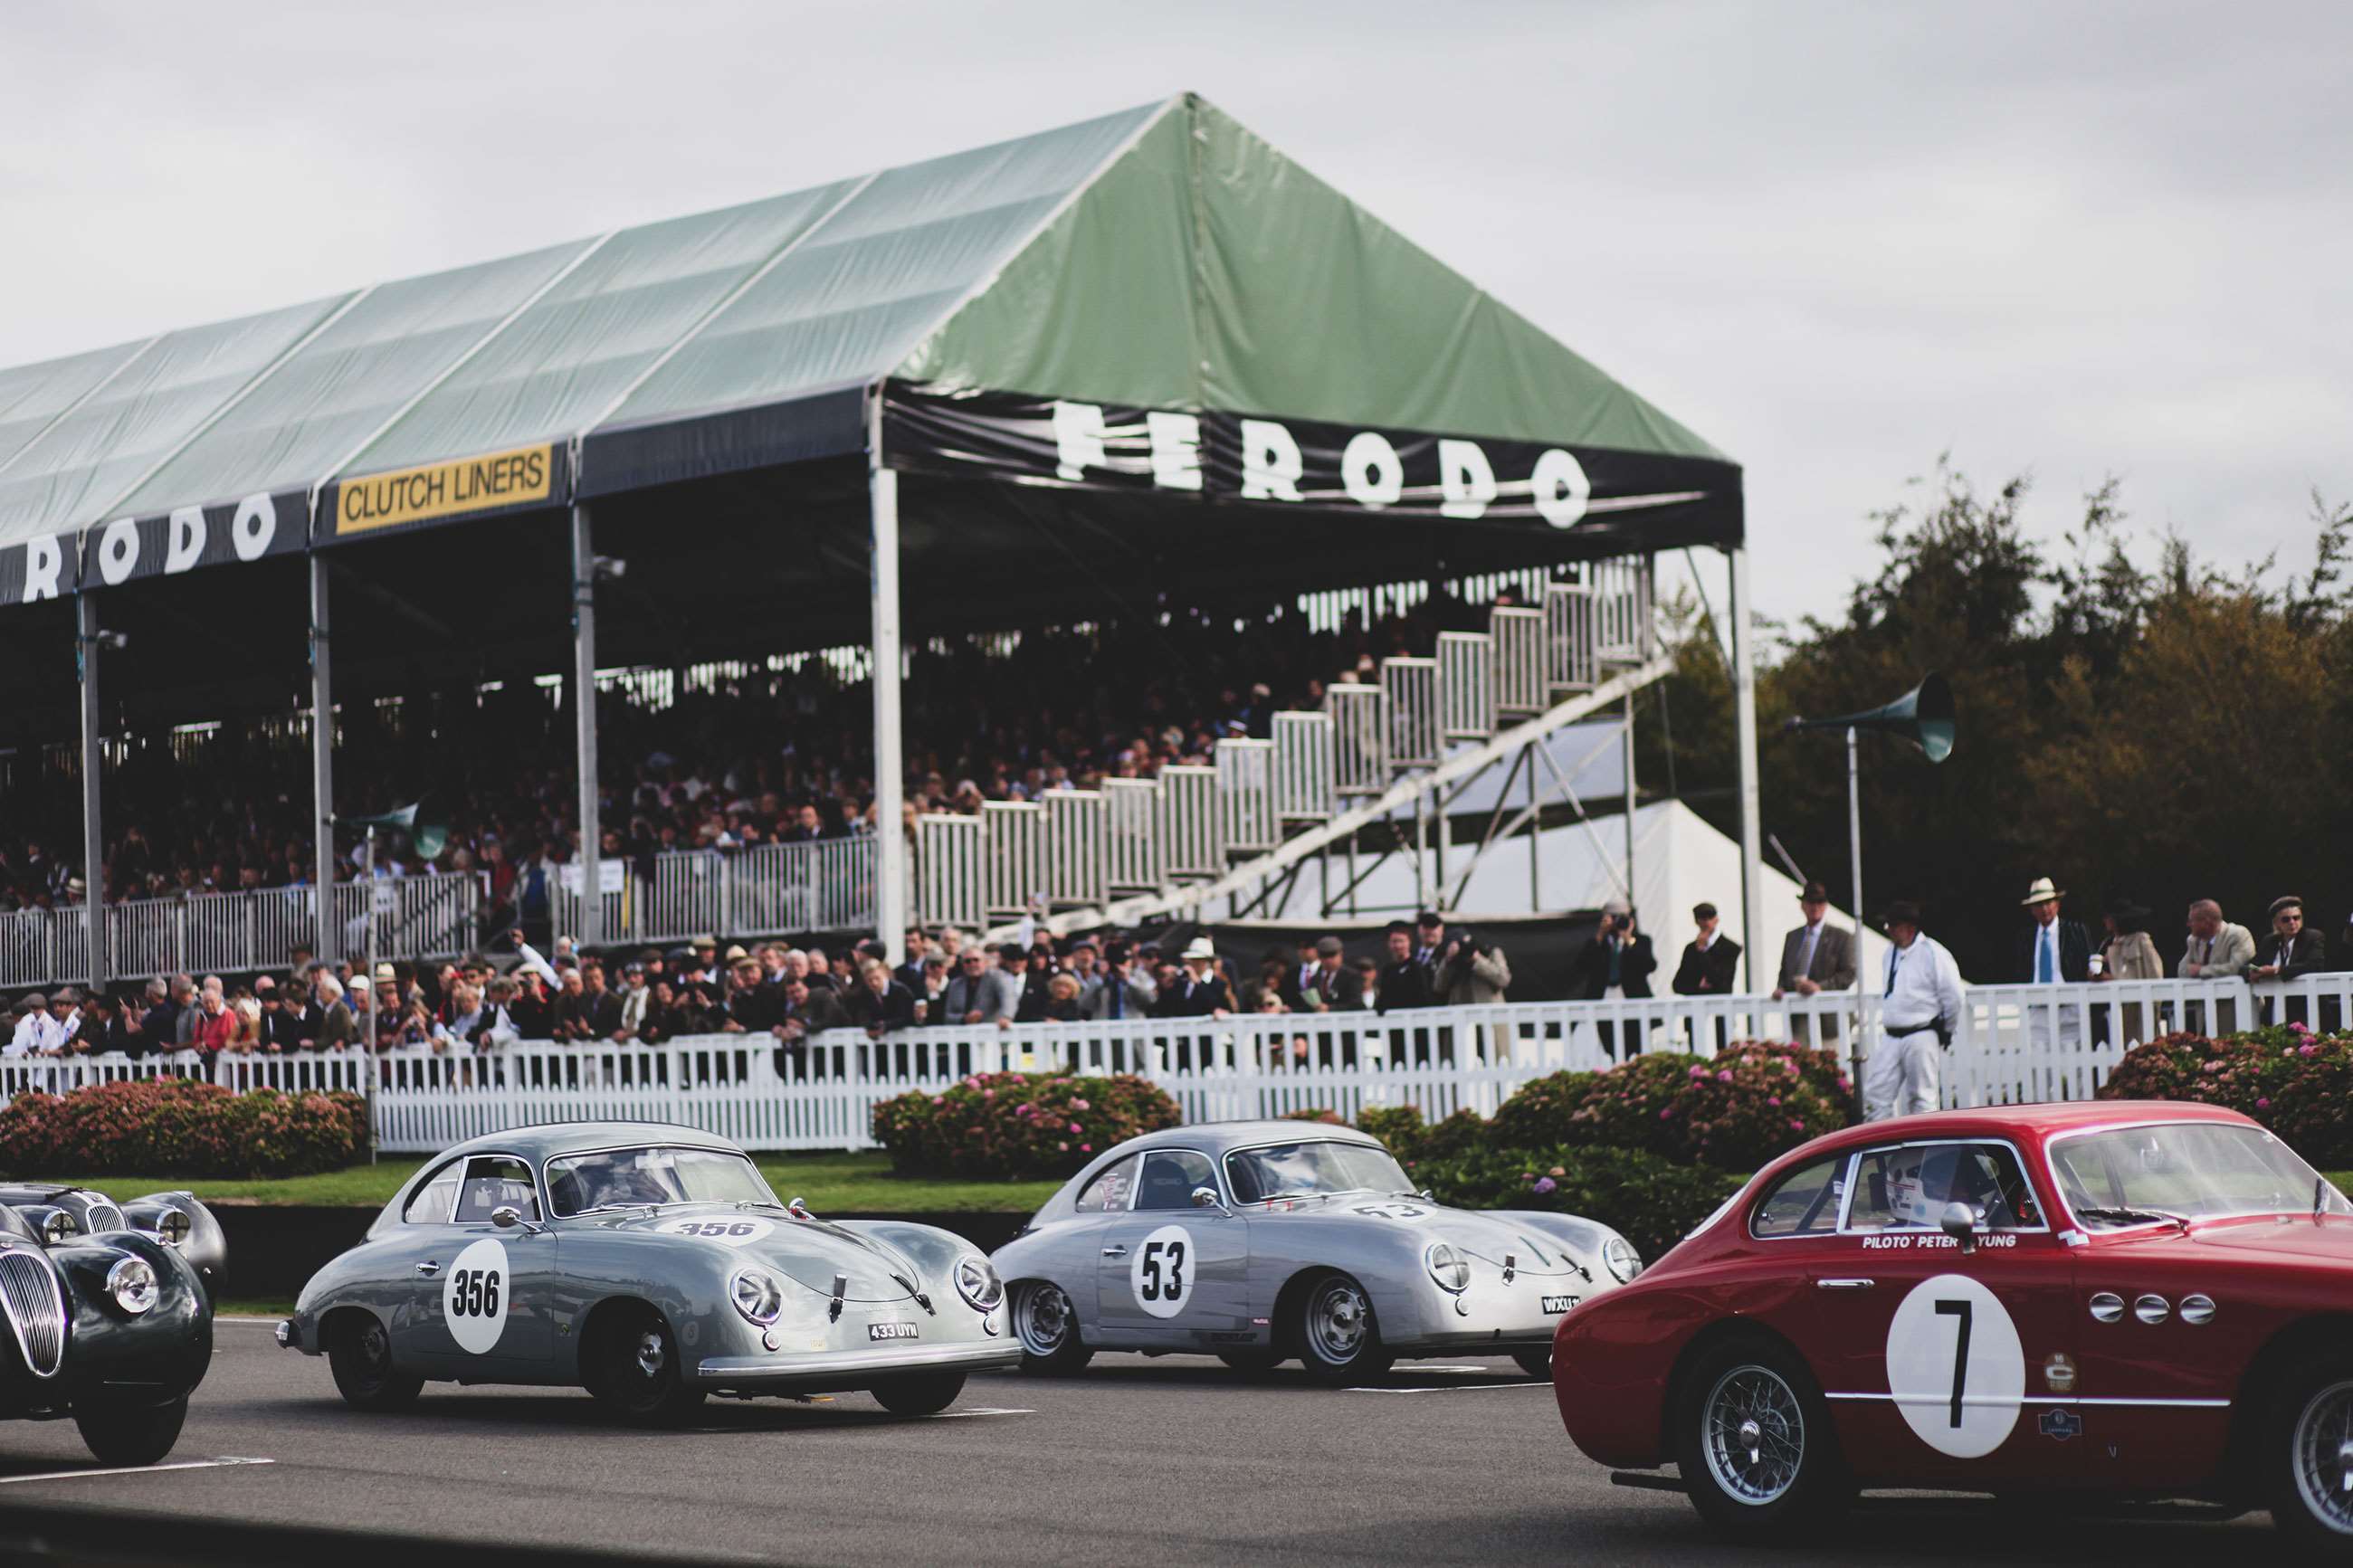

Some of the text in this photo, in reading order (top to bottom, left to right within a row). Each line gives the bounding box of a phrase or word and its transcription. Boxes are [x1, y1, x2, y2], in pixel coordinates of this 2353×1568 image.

[345, 451, 544, 522] CLUTCH LINERS
[1052, 400, 1591, 528] FERODO
[23, 491, 277, 603] RODO
[674, 1222, 757, 1237] 356
[1352, 1203, 1425, 1219] 53
[1917, 1236, 1958, 1248] PETER
[1977, 1234, 2016, 1248] YUNG
[452, 1269, 500, 1318] 356
[1142, 1241, 1185, 1301] 53
[871, 1323, 918, 1338] 433 UYN
[1935, 1299, 1973, 1429] 7
